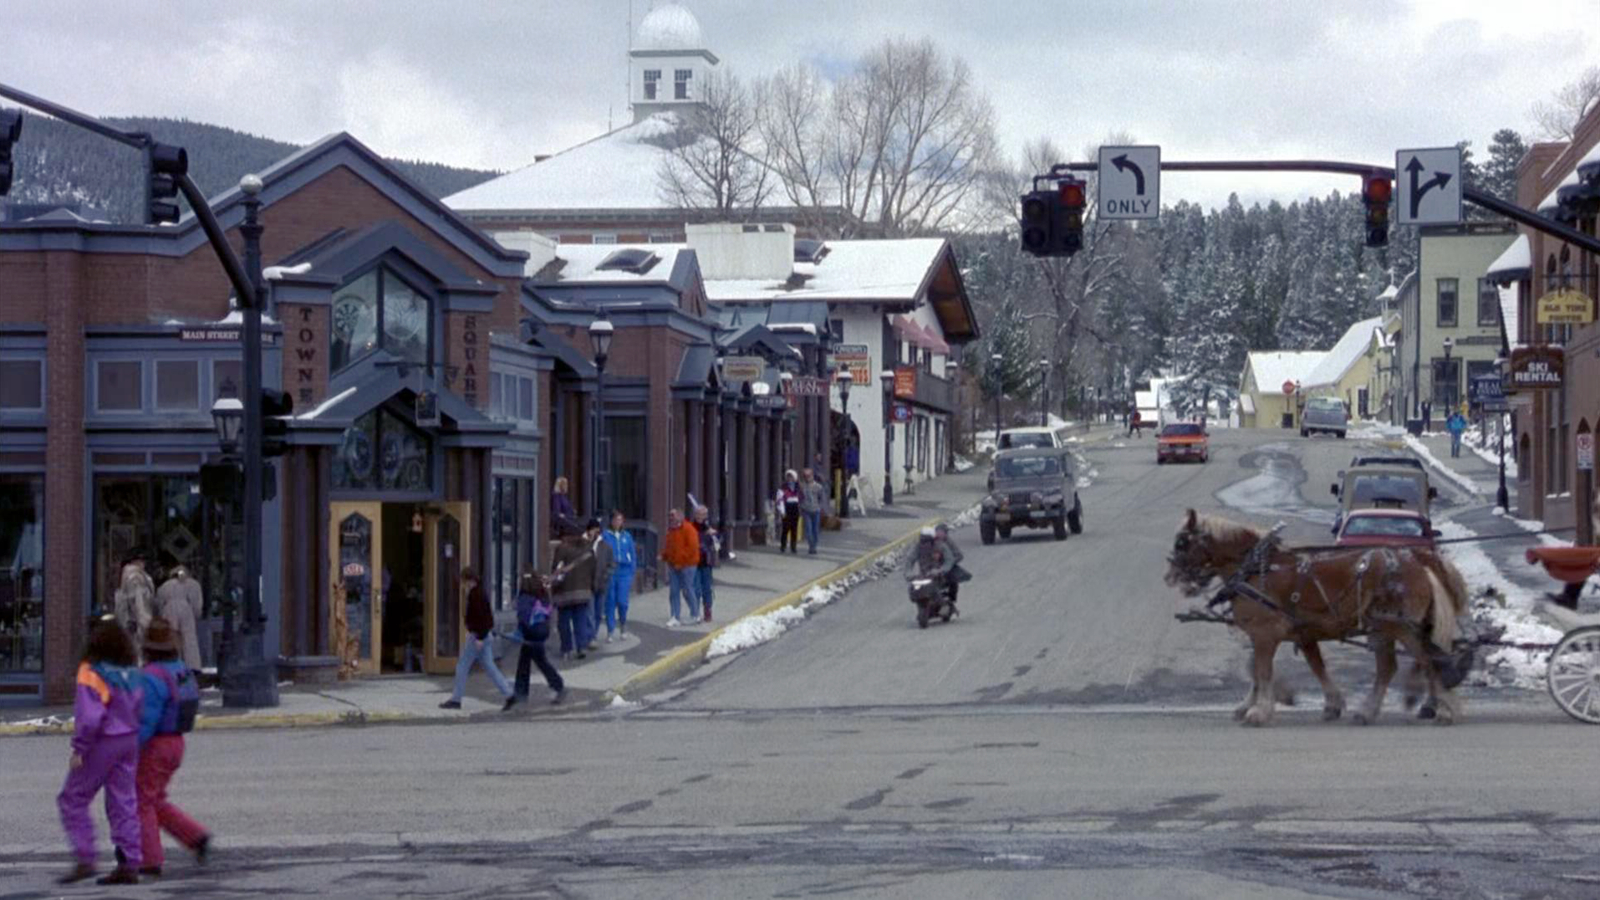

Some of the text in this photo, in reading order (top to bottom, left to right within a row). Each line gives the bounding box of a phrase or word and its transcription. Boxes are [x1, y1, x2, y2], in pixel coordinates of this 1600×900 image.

[1107, 199, 1151, 214] ONLY
[182, 331, 239, 339] MAIN STREET
[296, 307, 316, 402] TOWNE
[1528, 363, 1548, 371] SKI
[1515, 373, 1560, 381] RENTAL
